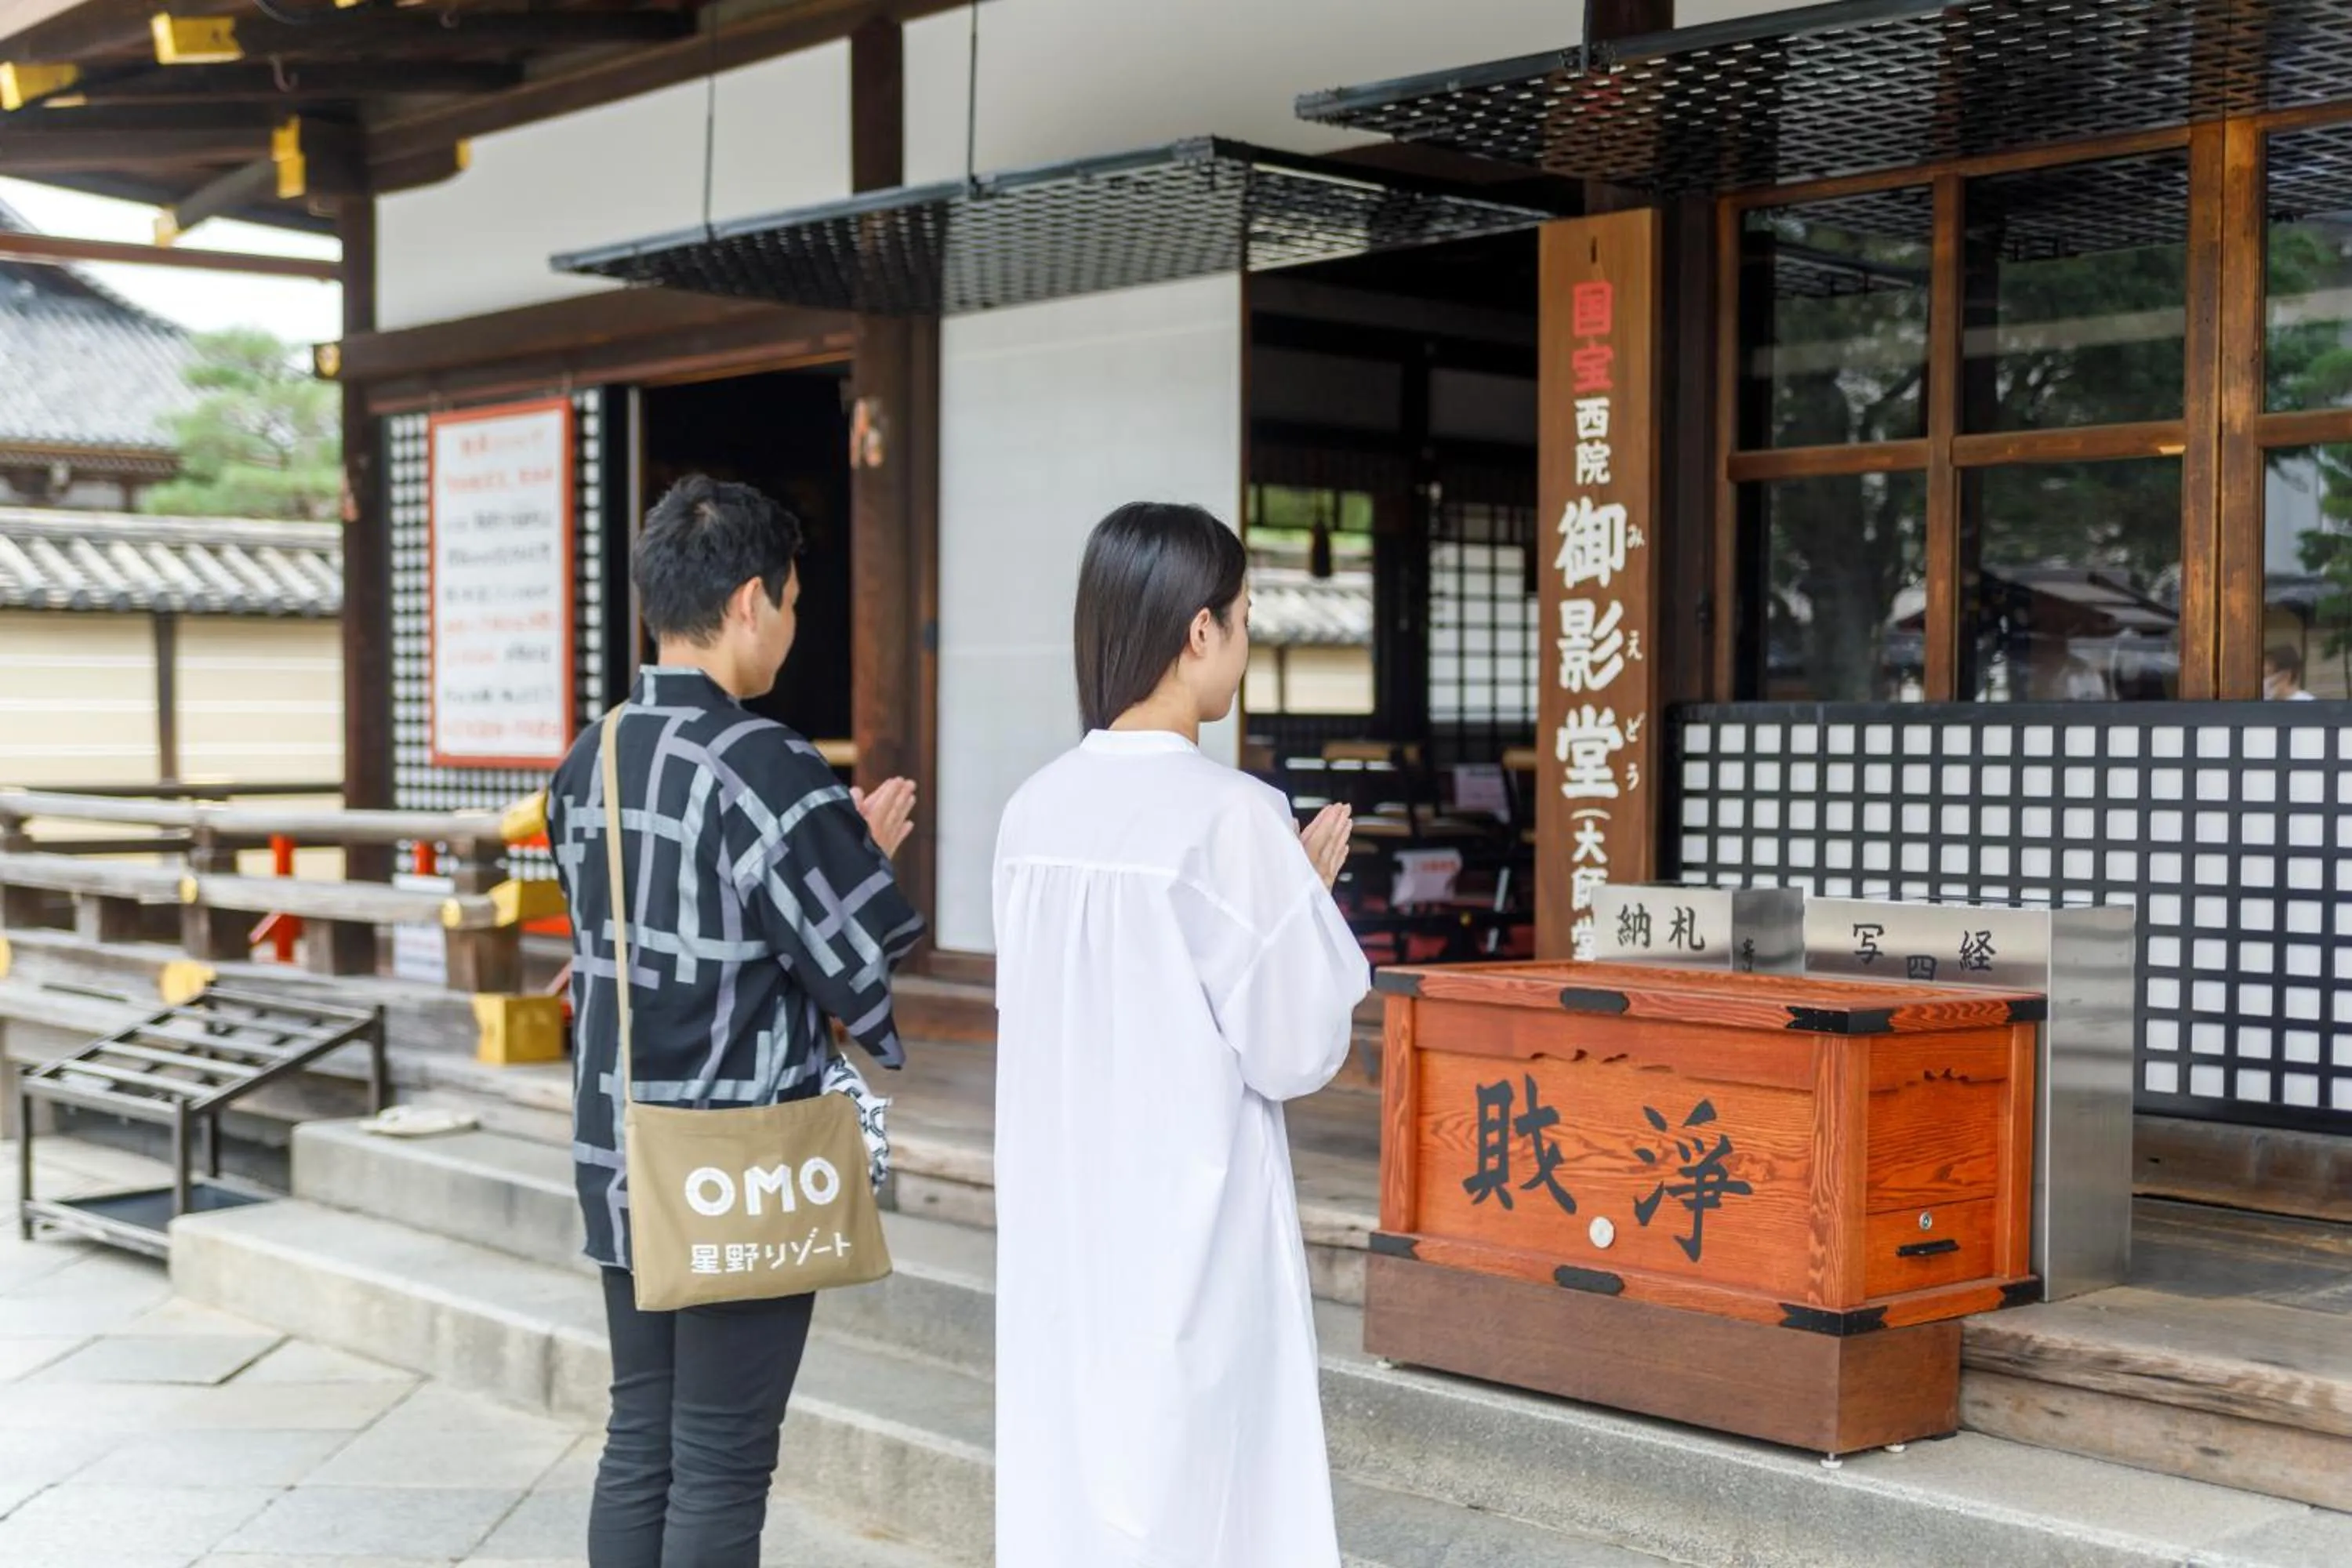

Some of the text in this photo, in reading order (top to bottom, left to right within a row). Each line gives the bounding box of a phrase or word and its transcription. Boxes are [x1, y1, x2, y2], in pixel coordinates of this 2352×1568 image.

[1616, 902, 1706, 951] 納札
[1906, 954, 1937, 981] 四
[684, 1156, 840, 1216] OMO
[691, 1227, 851, 1274] 星野リゾート
